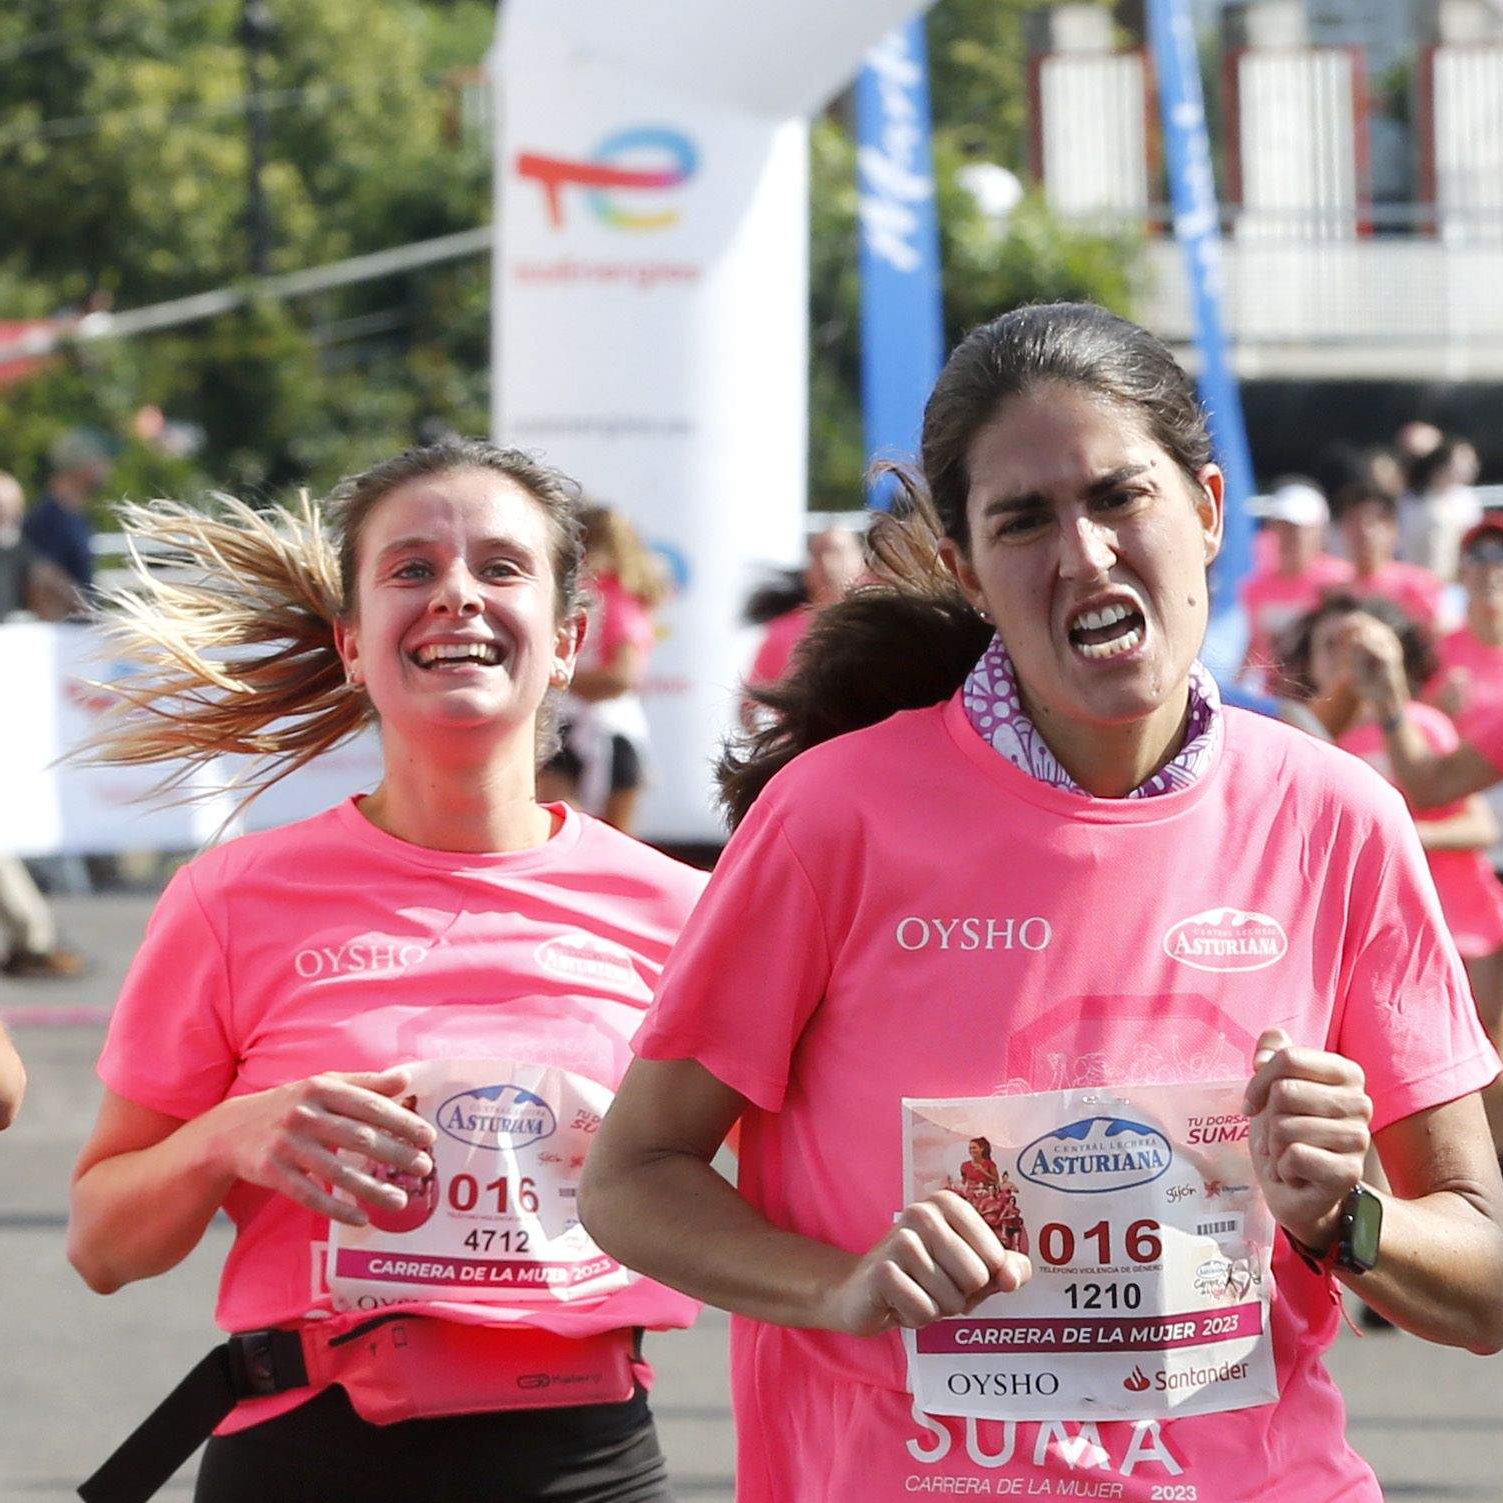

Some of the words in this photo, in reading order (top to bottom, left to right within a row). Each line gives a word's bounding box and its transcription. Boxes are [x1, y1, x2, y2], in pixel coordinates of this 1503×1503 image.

[897, 916, 1052, 951] OYSHO
[1175, 931, 1278, 955] ASTURIANA
[294, 944, 428, 978] OYSHO
[447, 1105, 544, 1135] ASTURIANA
[1188, 1118, 1203, 1127] TU
[1187, 1125, 1249, 1144] SUMA
[1054, 1143, 1105, 1153] CENTRAL
[1030, 1148, 1164, 1176] ASTURIANA
[448, 1173, 539, 1213] 016
[1166, 1184, 1196, 1203] gijón
[464, 1229, 530, 1253] 4712
[1039, 1219, 1163, 1265] 016
[368, 1259, 455, 1279] CARRERA
[460, 1266, 485, 1281] DE
[489, 1267, 513, 1282] LA
[572, 1259, 612, 1281] 2023
[1064, 1283, 1141, 1309] 1210
[954, 1325, 1056, 1345] CARRERA
[1062, 1326, 1090, 1344] DE
[1096, 1326, 1124, 1344] LA
[1130, 1323, 1195, 1343] MUJER
[1203, 1315, 1239, 1336] 2023
[948, 1373, 1059, 1396] OYSHO
[1155, 1361, 1249, 1390] Santander
[906, 1402, 1184, 1477] SUMA
[905, 1475, 991, 1494] CARRERA
[997, 1478, 1021, 1494] DE
[1028, 1479, 1051, 1495] LA
[1057, 1480, 1123, 1499] MUJER
[1152, 1485, 1197, 1500] 2023
